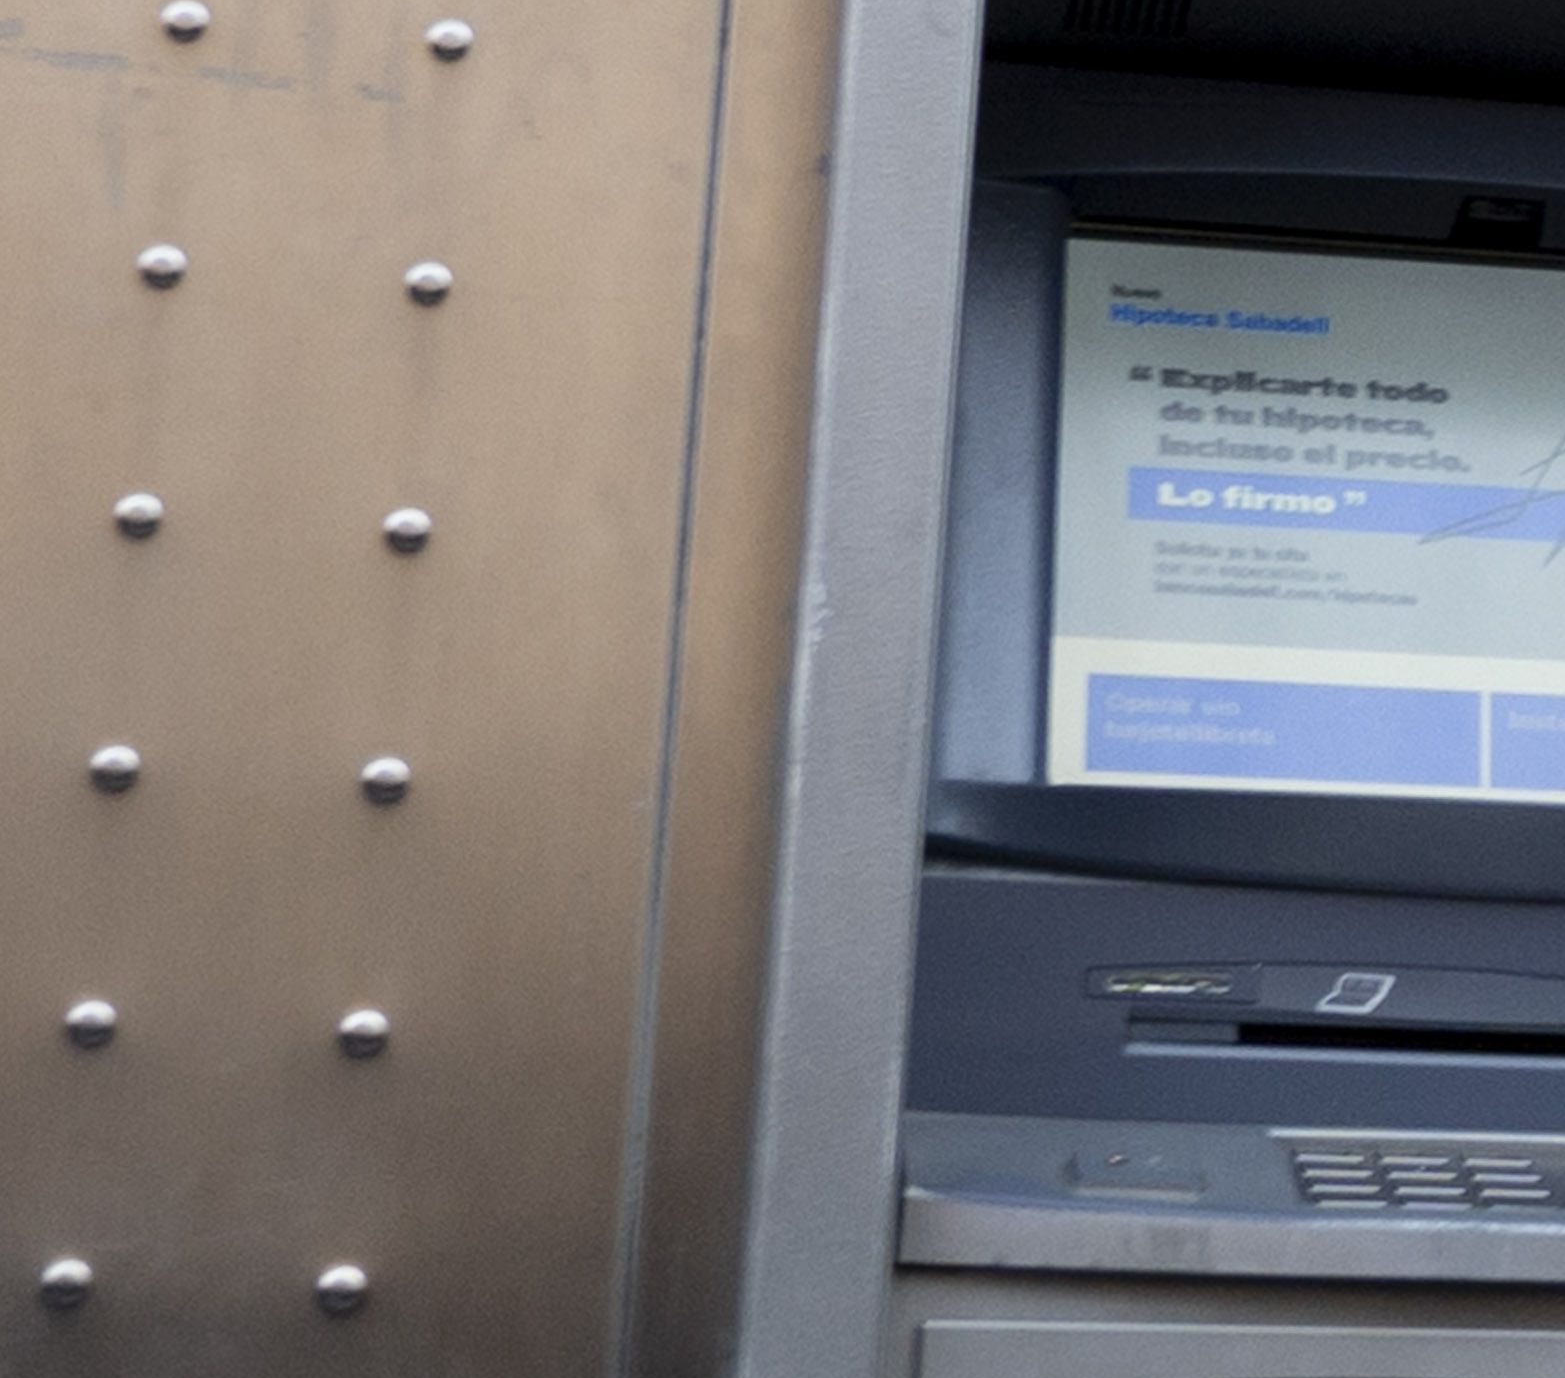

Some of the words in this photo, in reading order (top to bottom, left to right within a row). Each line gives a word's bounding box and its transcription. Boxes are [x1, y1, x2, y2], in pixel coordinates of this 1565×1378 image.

[1109, 303, 1220, 329] Hipoteca
[1225, 309, 1331, 335] Sabadell
[1366, 379, 1450, 404] todo
[1160, 401, 1204, 423] de
[1214, 404, 1256, 425] tu
[1303, 443, 1337, 467] el
[1157, 482, 1214, 509] Lo
[1222, 484, 1337, 514] firmo
